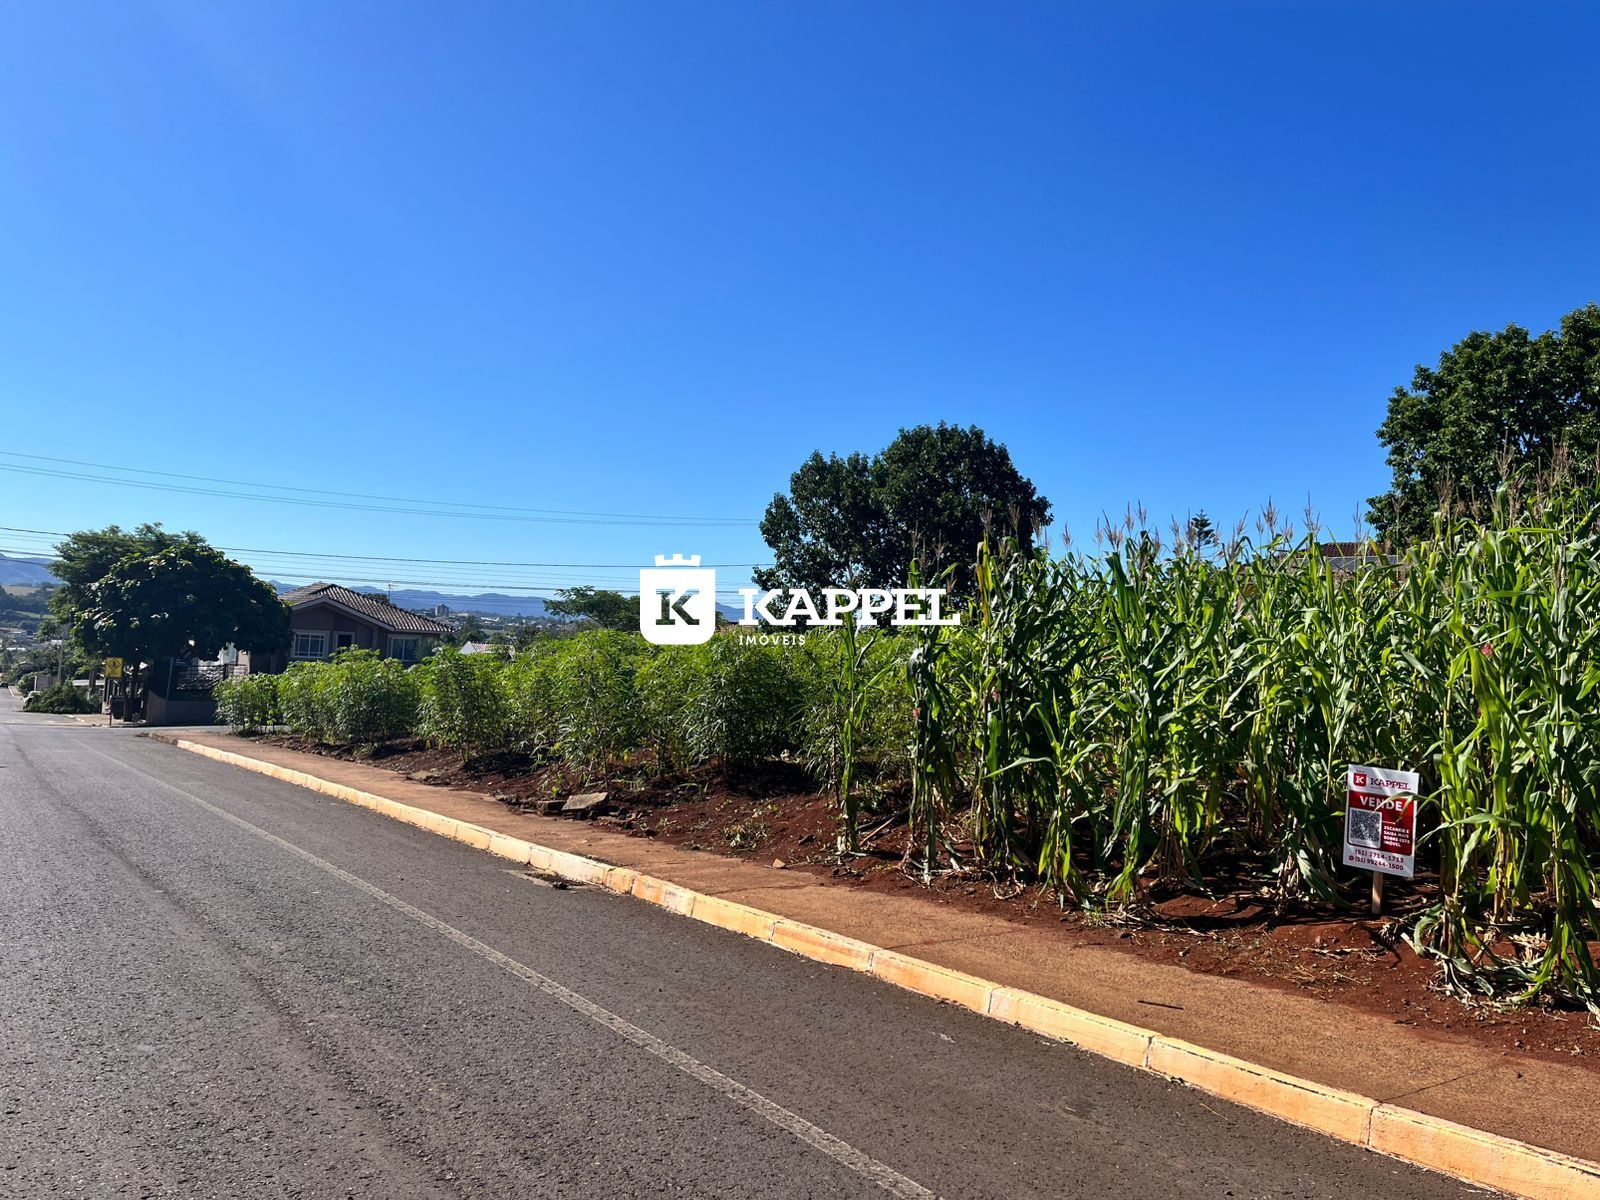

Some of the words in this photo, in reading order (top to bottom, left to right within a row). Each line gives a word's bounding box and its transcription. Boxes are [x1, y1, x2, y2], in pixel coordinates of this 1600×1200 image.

[1370, 777, 1410, 790] KAPPEL
[1359, 794, 1403, 812] VENDE
[1355, 849, 1367, 857] (51)
[1368, 852, 1404, 864] 3714-1713
